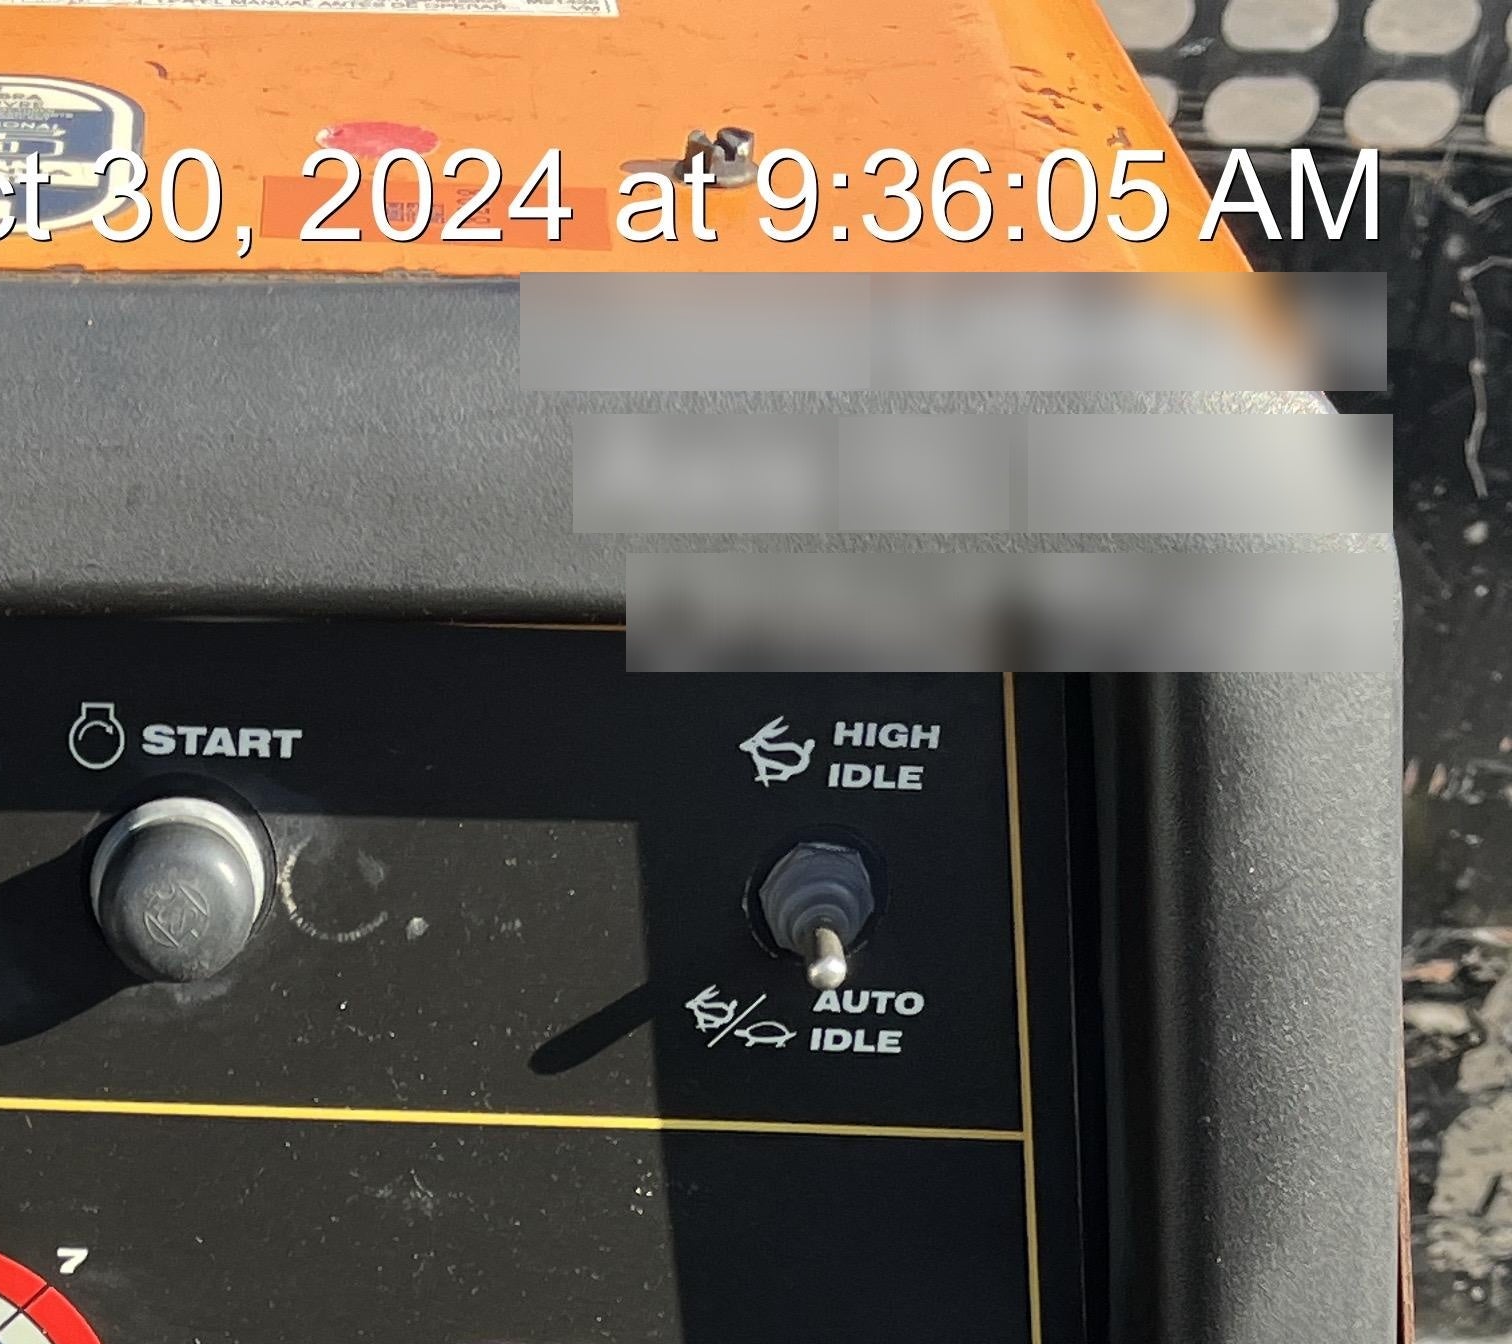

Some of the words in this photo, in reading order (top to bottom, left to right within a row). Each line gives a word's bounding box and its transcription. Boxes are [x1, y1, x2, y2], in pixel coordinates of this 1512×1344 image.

[141, 724, 304, 759] START
[832, 721, 942, 749] HIGH
[827, 763, 925, 790] IDLE
[812, 989, 925, 1016] AUTO
[809, 1028, 903, 1054] IDLE
[56, 1247, 90, 1275] 7
